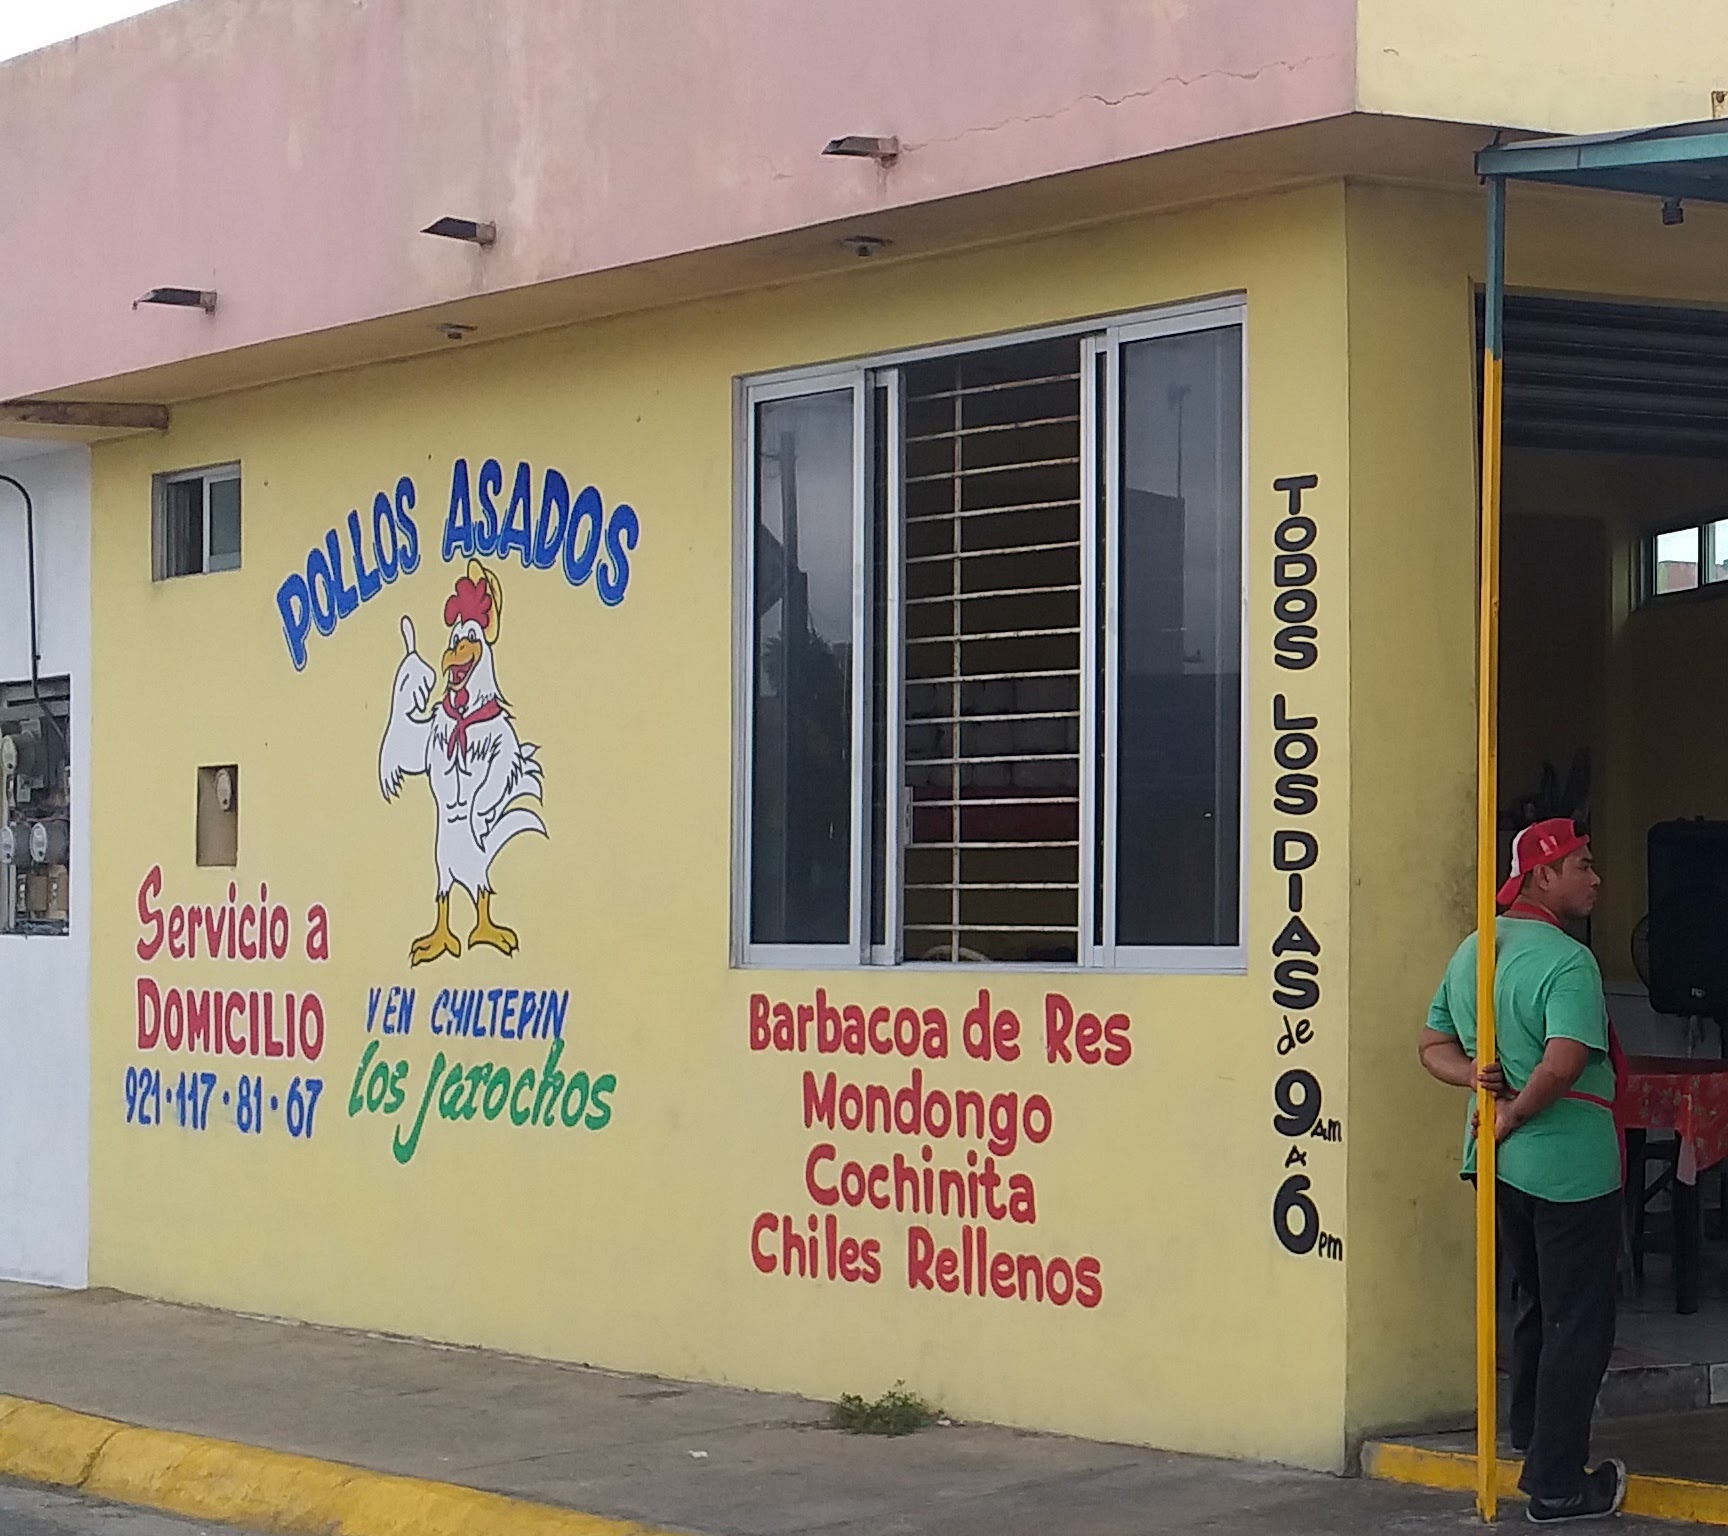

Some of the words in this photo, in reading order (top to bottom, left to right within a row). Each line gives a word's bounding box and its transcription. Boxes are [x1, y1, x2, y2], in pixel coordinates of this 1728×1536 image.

[276, 475, 422, 672] POLLOS
[441, 458, 639, 606] ASADOS
[1273, 474, 1320, 671] TODOS
[1273, 694, 1320, 816] LOS
[136, 866, 290, 961] Servicio
[304, 901, 330, 962] a
[1272, 829, 1321, 1011] DIAS
[136, 977, 325, 1062] DOMICILIO
[430, 987, 570, 1040] CHILTEPIN
[748, 987, 950, 1061] Barbacoa
[962, 988, 1022, 1063] de
[1044, 992, 1134, 1066] Res
[1275, 1014, 1315, 1056] de
[802, 1067, 1054, 1157] Mondongo
[804, 1142, 1037, 1225] Cochinita
[749, 1211, 882, 1284] Chiles
[907, 1224, 1104, 1309] Rellenos
